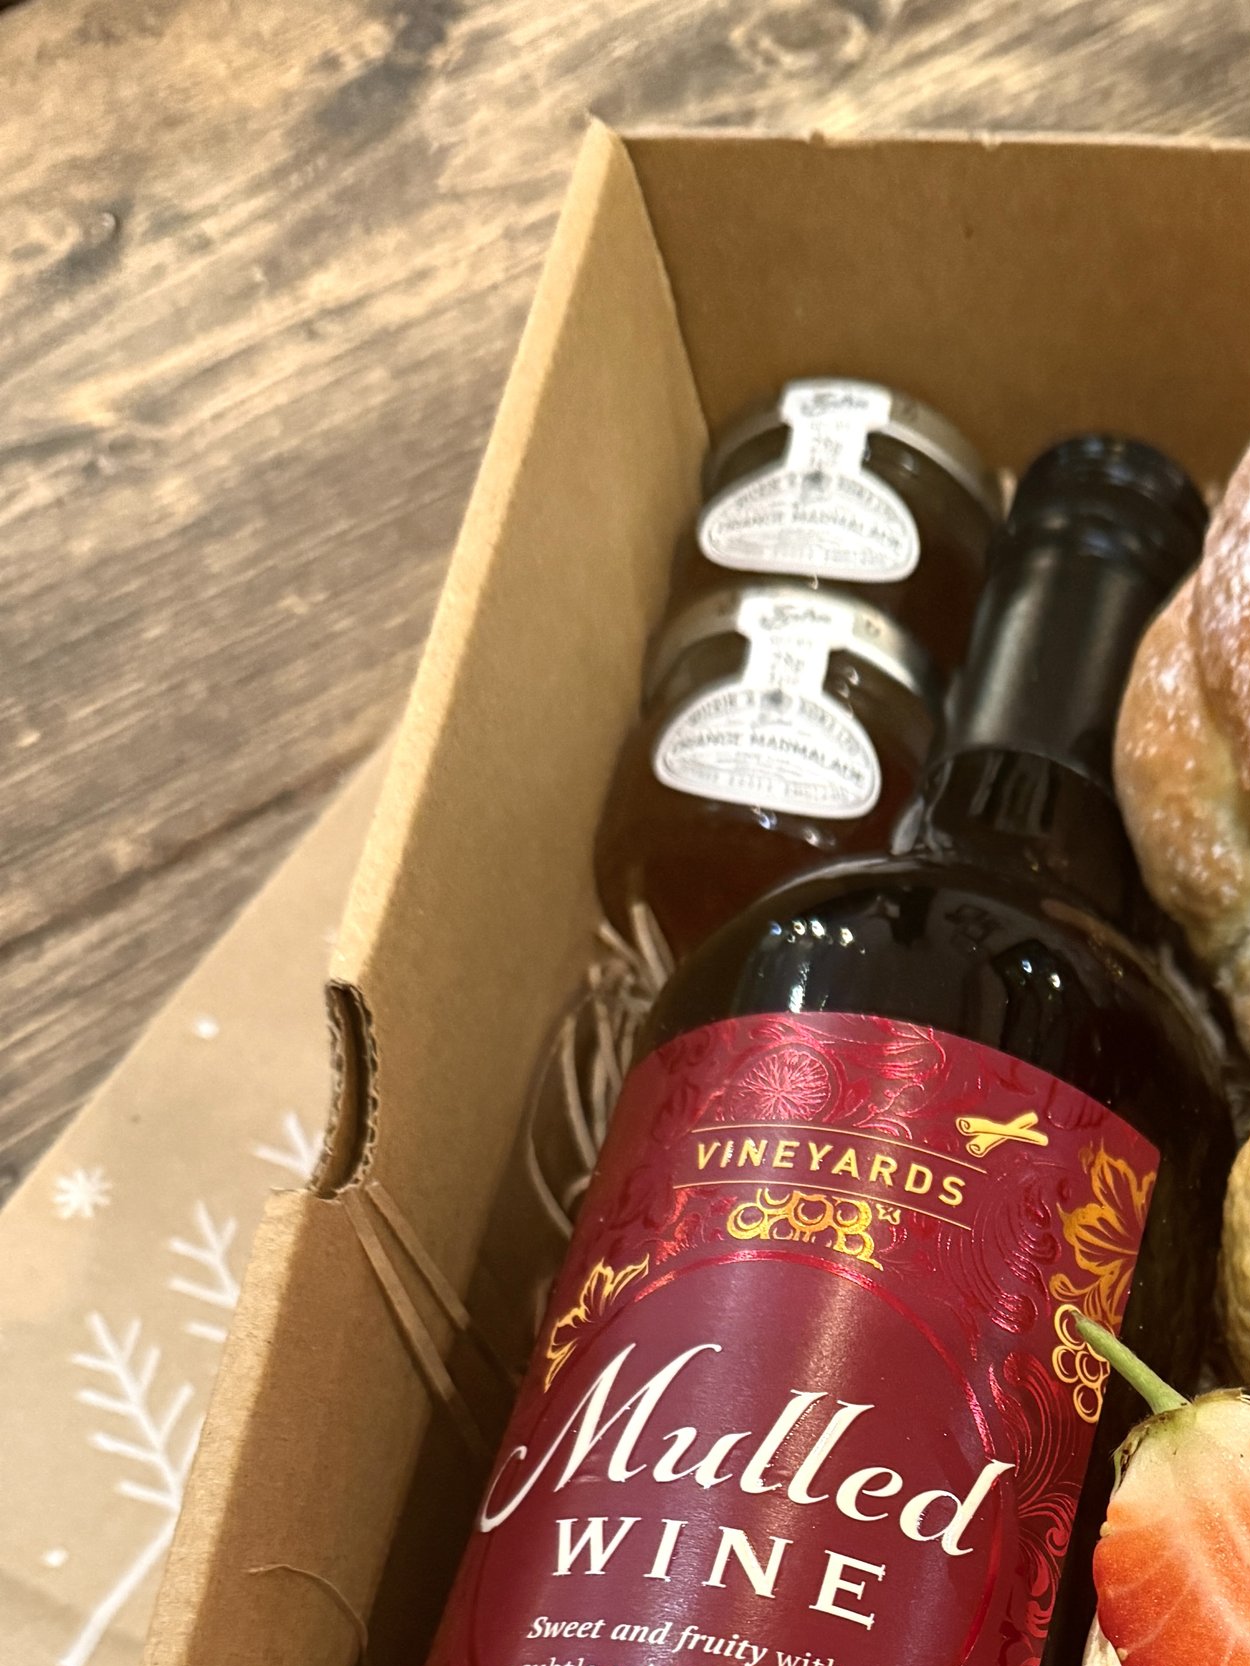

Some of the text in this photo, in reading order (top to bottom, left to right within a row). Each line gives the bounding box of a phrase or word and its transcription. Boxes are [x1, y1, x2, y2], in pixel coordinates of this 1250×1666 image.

[697, 1139, 966, 1207] VINEYARDS
[479, 1342, 1015, 1557] Mulled
[551, 1515, 887, 1631] WINE
[526, 1616, 605, 1640] Sweet
[610, 1621, 672, 1646] and
